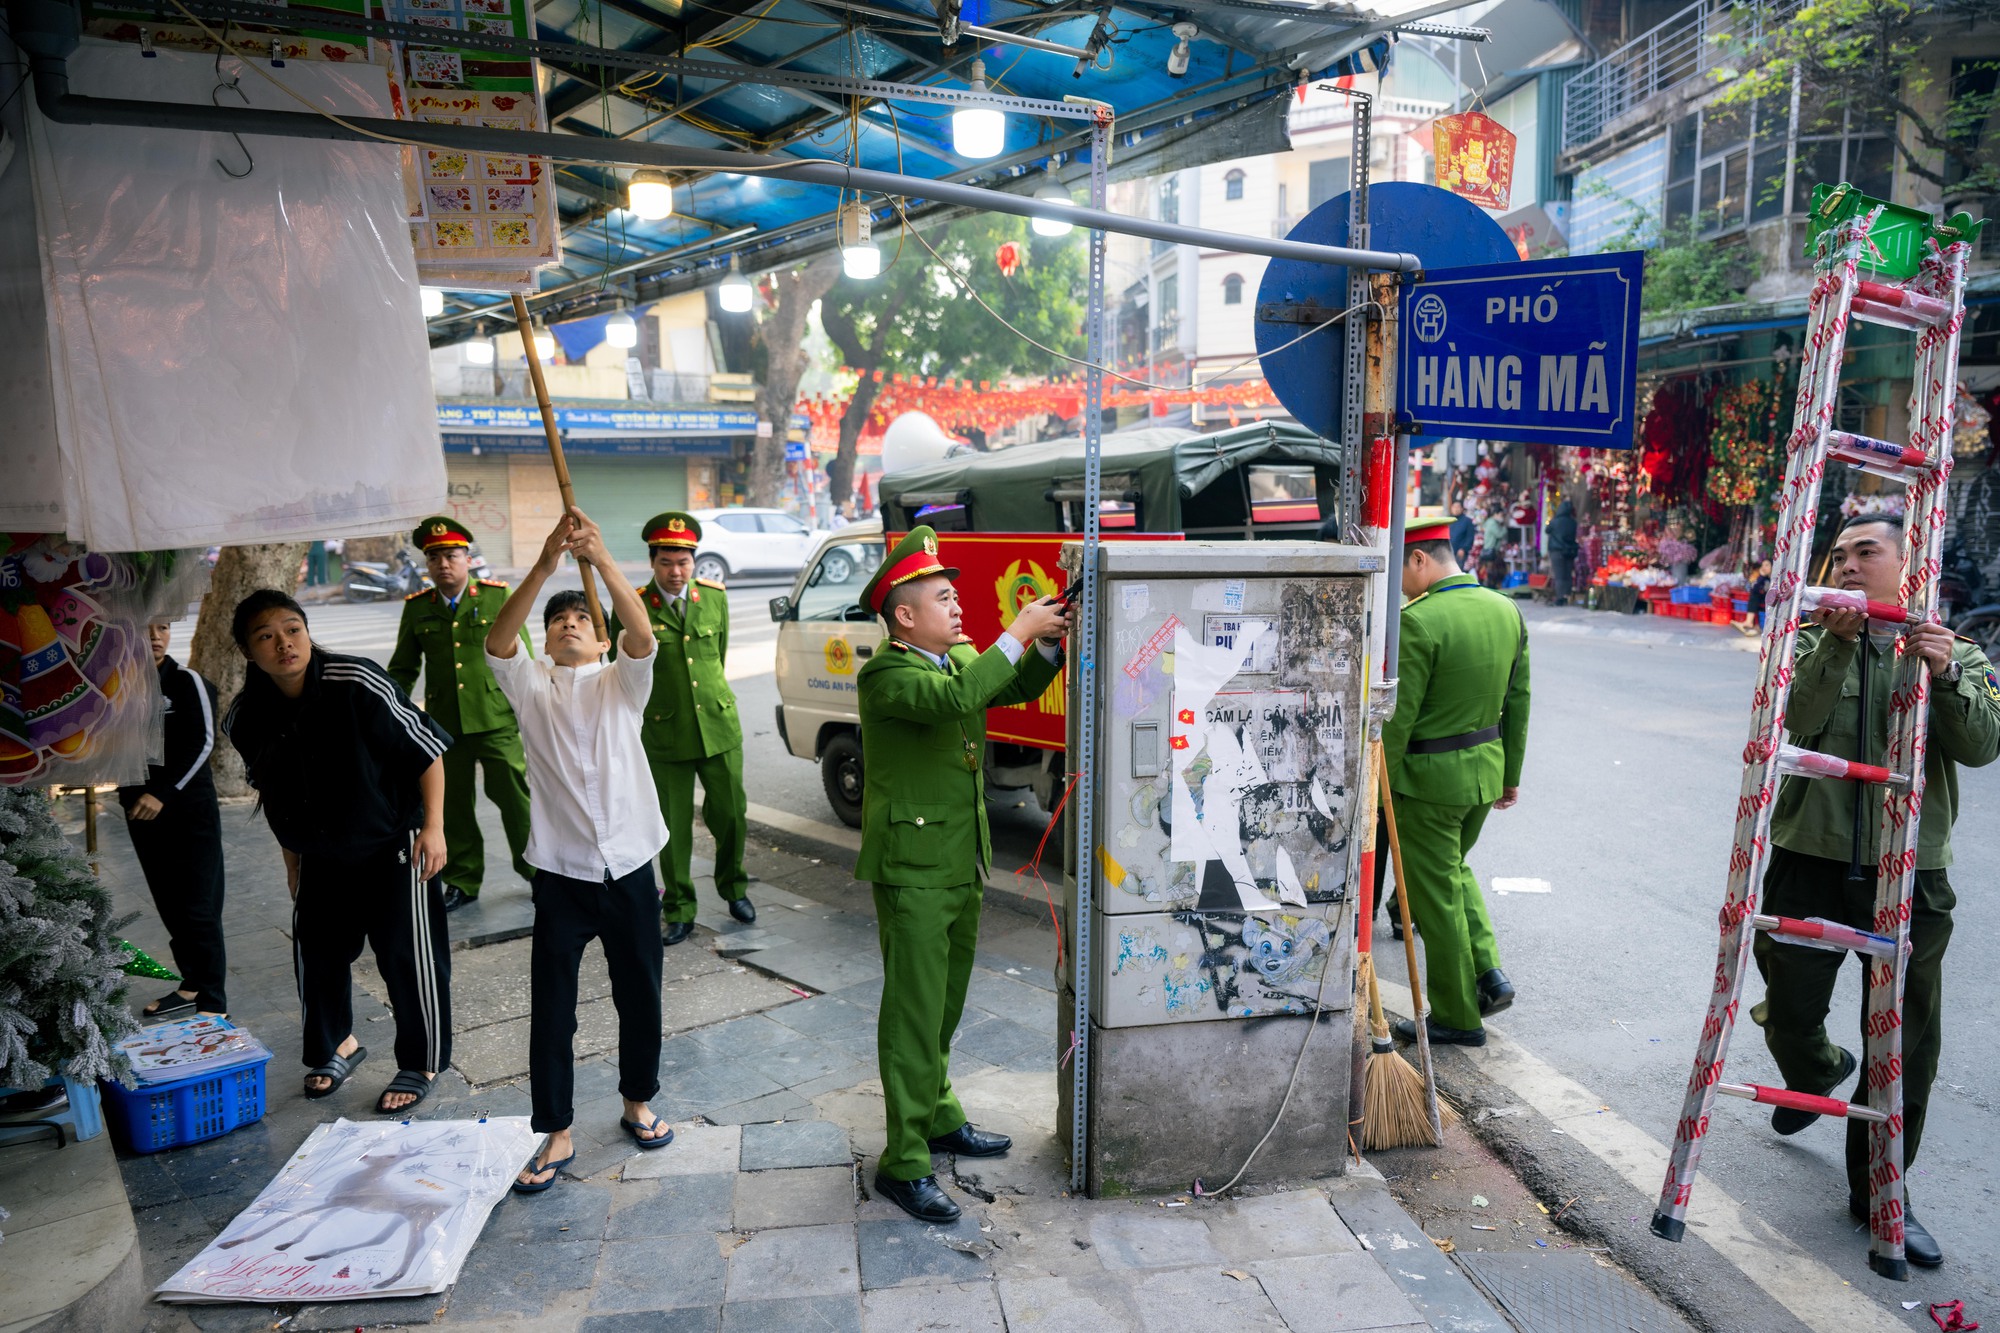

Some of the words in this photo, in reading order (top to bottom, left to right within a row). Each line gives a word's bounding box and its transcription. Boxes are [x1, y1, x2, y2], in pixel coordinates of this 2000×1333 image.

[1486, 280, 1564, 324] PHỐ
[1416, 341, 1523, 411] HÀNG
[1538, 340, 1611, 414] MÃ
[1223, 622, 1236, 631] TBA
[808, 677, 830, 690] CÔNG
[832, 681, 844, 691] AN
[1205, 706, 1234, 723] CẤM
[204, 1252, 318, 1287] Merry
